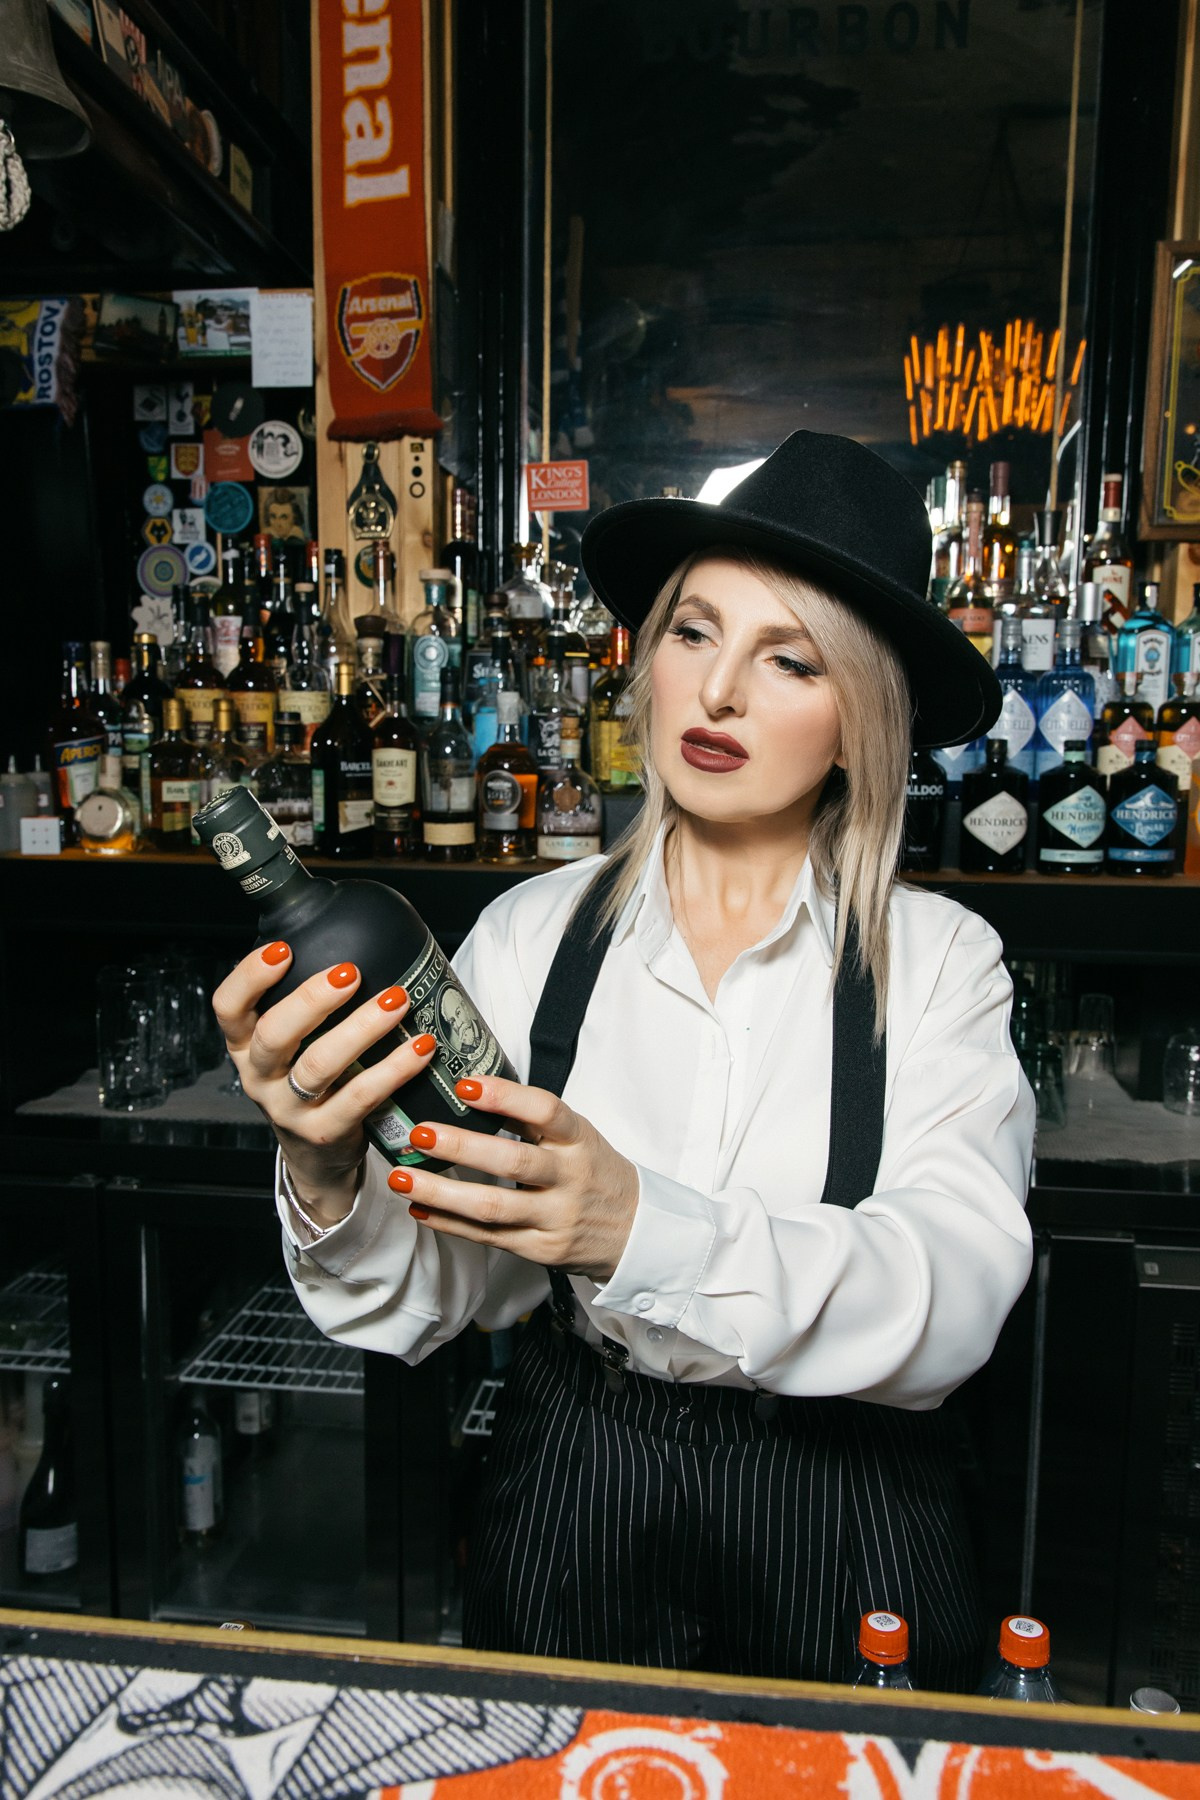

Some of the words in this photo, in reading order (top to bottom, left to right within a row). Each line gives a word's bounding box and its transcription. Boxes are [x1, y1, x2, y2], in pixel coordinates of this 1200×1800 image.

[348, 290, 412, 315] Arsenal
[37, 310, 57, 400] ROSTOV
[530, 488, 583, 500] LONDON
